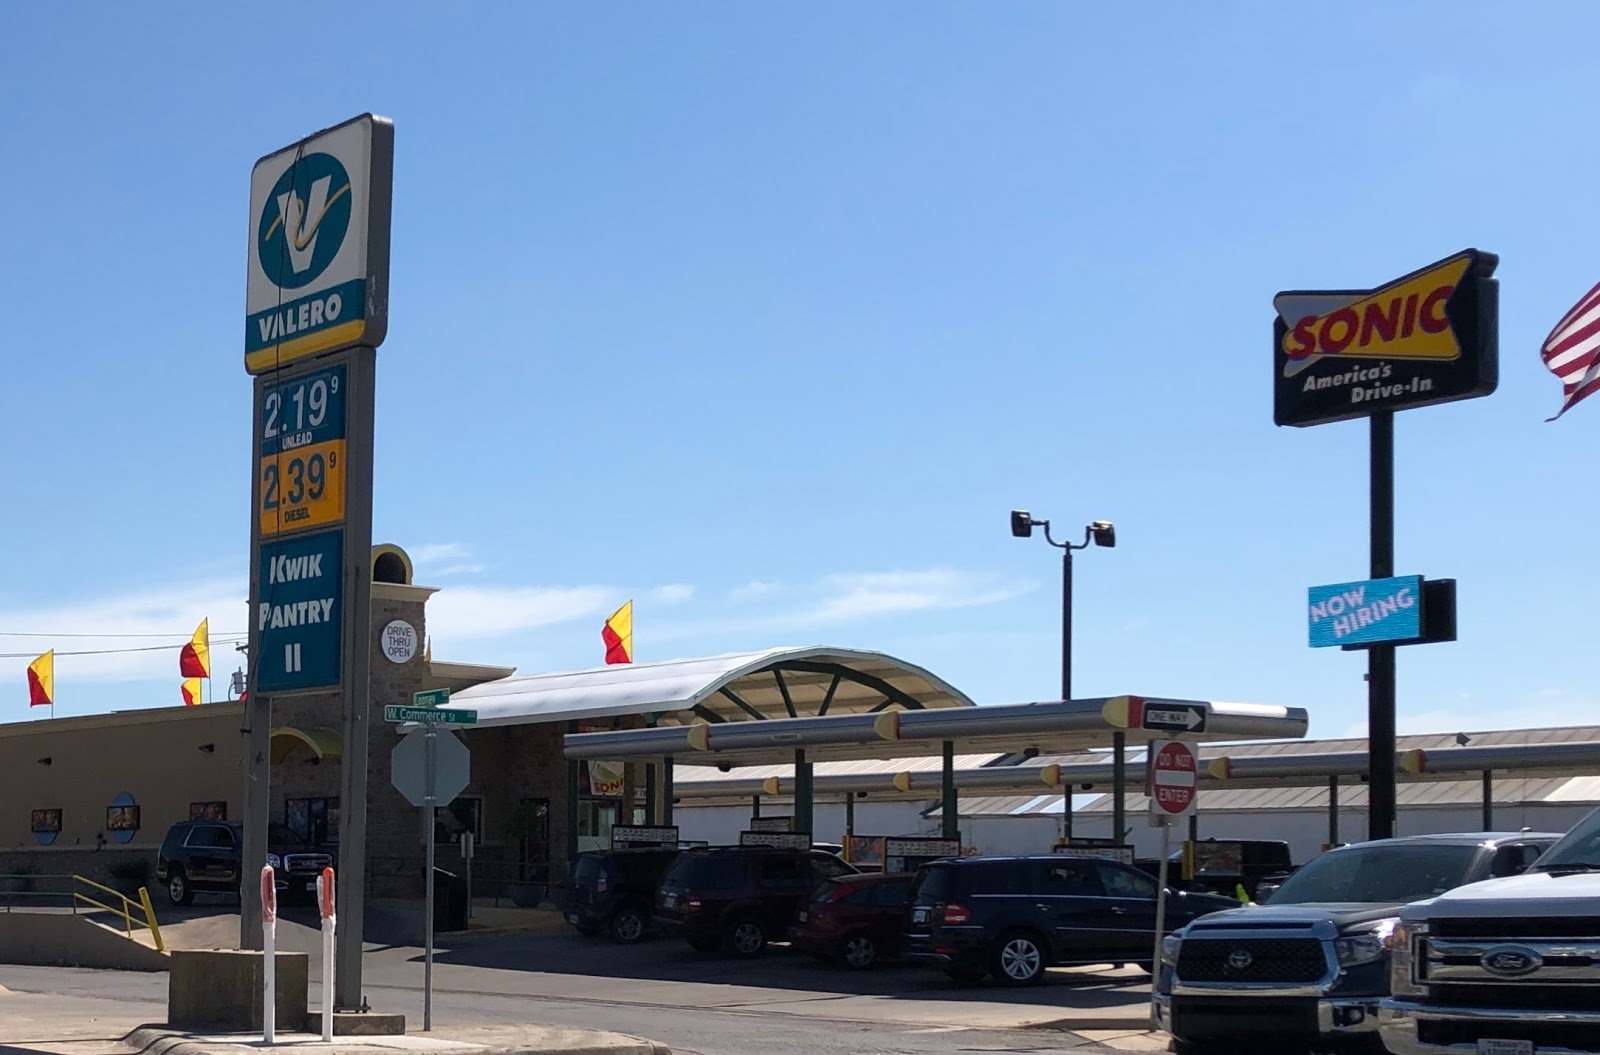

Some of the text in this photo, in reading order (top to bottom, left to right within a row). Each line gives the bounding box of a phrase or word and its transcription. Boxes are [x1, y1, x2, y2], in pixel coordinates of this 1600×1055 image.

[259, 293, 342, 342] VALERO
[1288, 285, 1455, 361] SONIC
[331, 375, 339, 394] 9
[1303, 361, 1392, 392] America's
[282, 431, 312, 450] UNLEAD
[329, 451, 337, 469] 9
[284, 506, 310, 523] DIESEL
[269, 553, 323, 584] KWIK
[1310, 586, 1365, 622] NOW
[259, 598, 334, 631] PANTRY
[1333, 588, 1414, 639] HIRING
[387, 626, 411, 637] DRIVE
[389, 636, 410, 647] THRU
[387, 646, 410, 657] OPEN
[400, 708, 447, 722] Commerce
[1149, 711, 1187, 723] ONE WAY
[1160, 753, 1192, 768] DO NOT
[1160, 788, 1190, 803] ENTER
